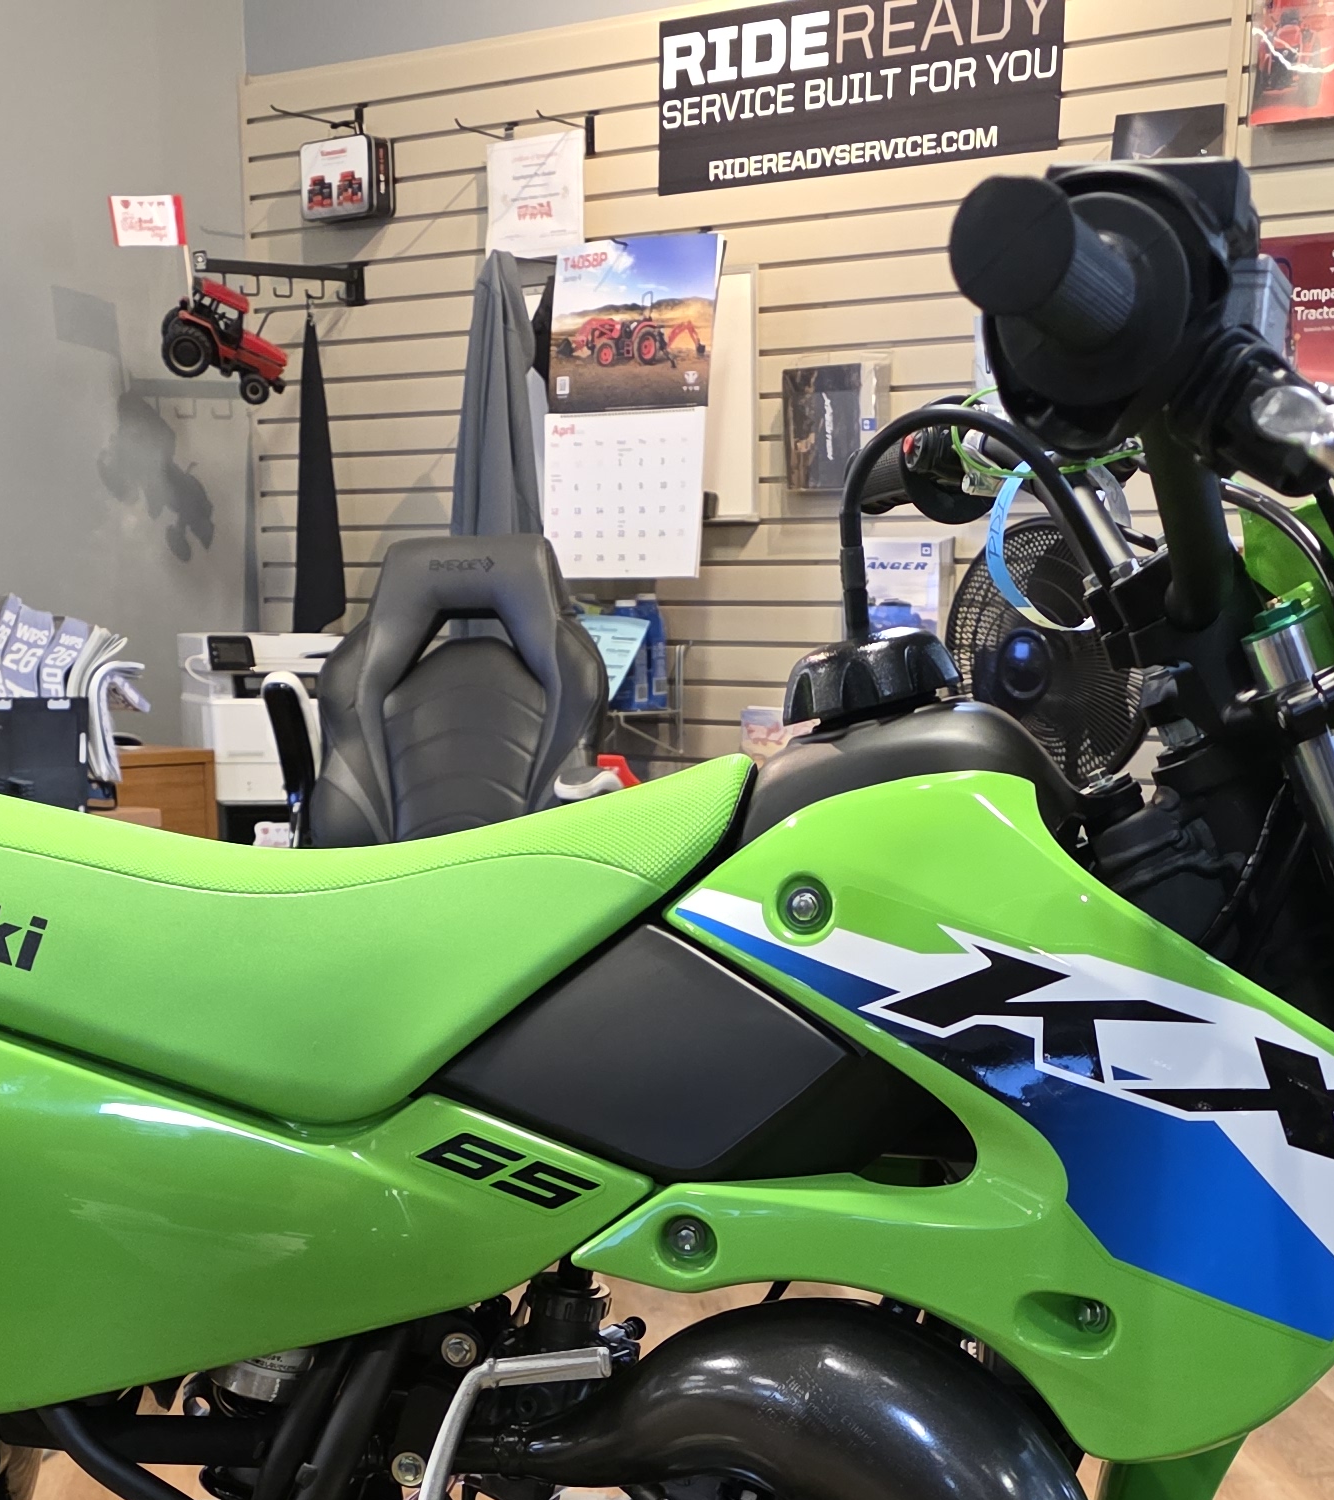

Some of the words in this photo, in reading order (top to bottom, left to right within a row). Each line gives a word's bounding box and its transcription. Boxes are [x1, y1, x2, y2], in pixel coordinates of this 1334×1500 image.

[662, 83, 795, 129] SERVICE
[804, 67, 902, 110] BUILT
[909, 57, 977, 97] FOR
[985, 45, 1058, 84] YOU
[708, 126, 998, 182] RIDEREADYSERVICE.COM
[552, 424, 575, 437] April
[867, 561, 928, 570] ANGER
[16, 622, 50, 645] WPS
[59, 633, 85, 649] WPS
[2, 641, 44, 674] 26
[44, 646, 78, 667] 26
[415, 1132, 601, 1209] 65
